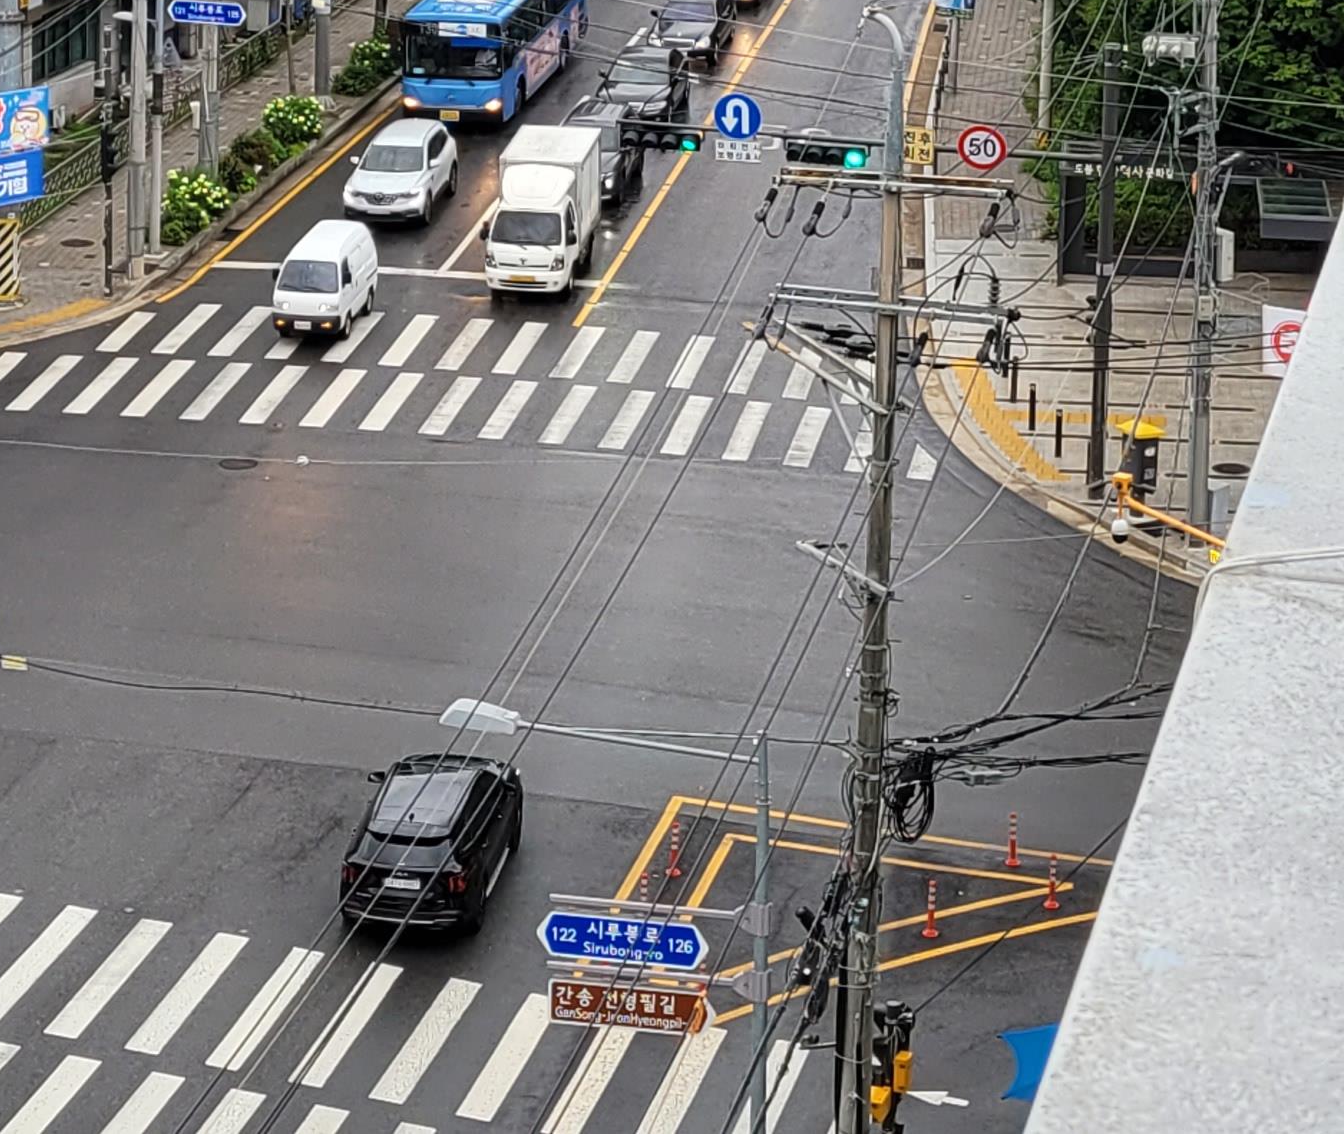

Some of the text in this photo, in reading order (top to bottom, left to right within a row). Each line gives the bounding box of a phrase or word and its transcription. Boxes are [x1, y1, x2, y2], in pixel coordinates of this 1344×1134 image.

[904, 129, 931, 143] 진후
[904, 144, 931, 161] 회전
[968, 137, 997, 158] 50
[551, 926, 578, 943] 122
[586, 920, 661, 945] 시루봉로
[582, 941, 664, 961] Sirubong-ro
[667, 938, 694, 954] 126
[555, 985, 675, 1016] 간송 전형필길
[554, 1006, 690, 1030] GanSong-JeonHyeongpil-
